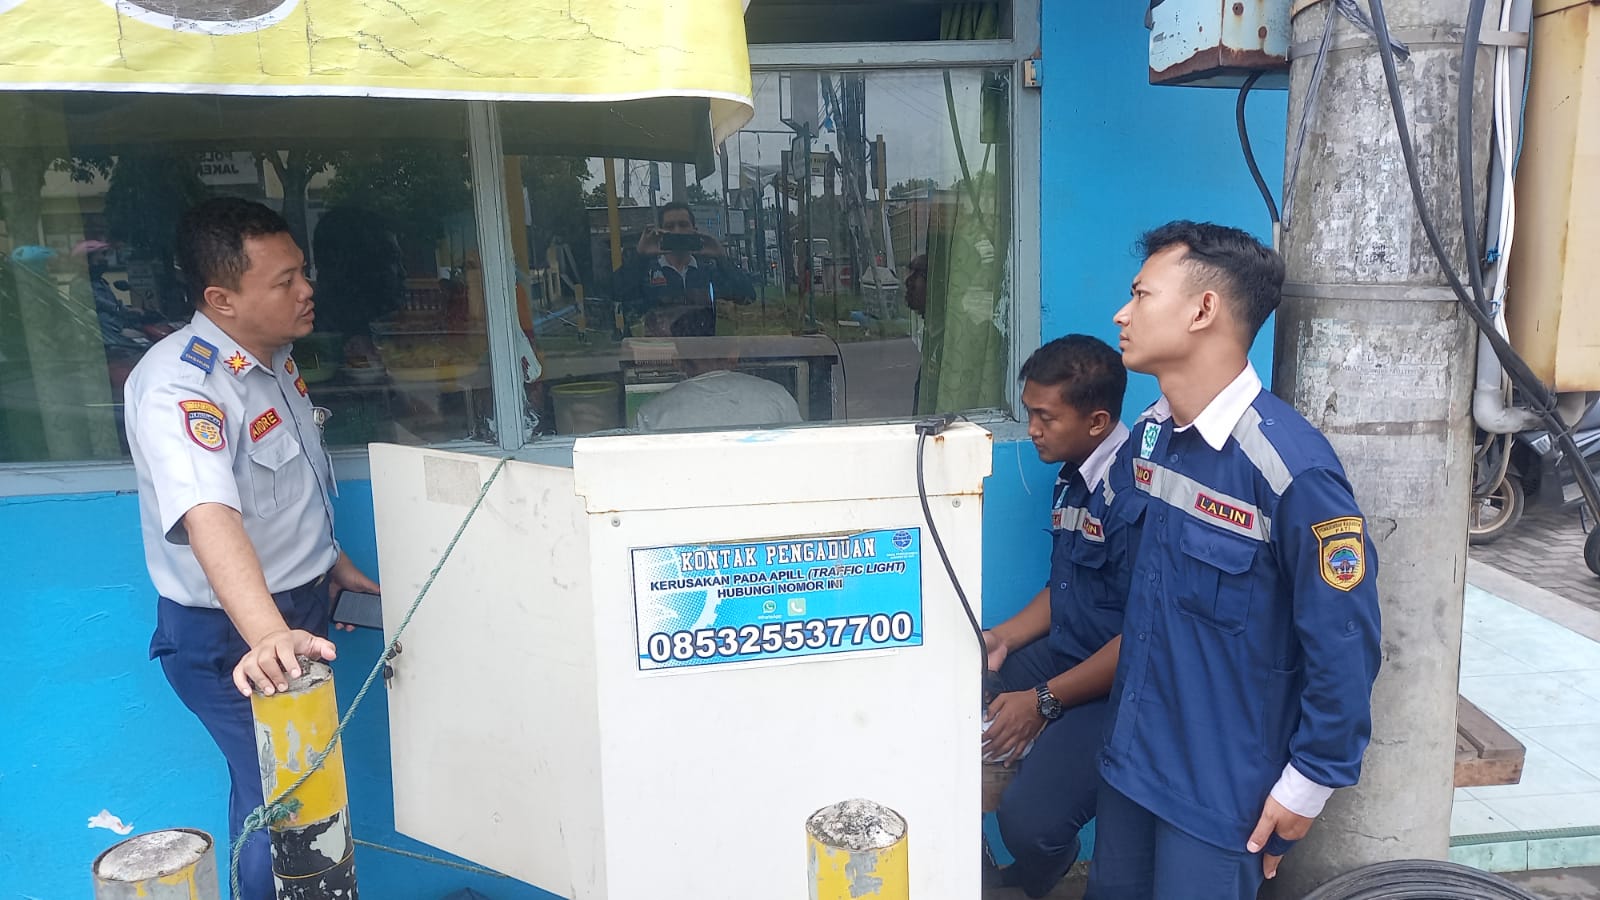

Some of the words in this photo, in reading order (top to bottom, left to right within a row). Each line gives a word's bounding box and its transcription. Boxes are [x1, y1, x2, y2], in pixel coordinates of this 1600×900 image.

[253, 411, 278, 438] ANDRE
[1200, 497, 1246, 524] LALIN
[680, 546, 757, 572] KONTAK
[766, 538, 876, 565] PENGADUAN
[650, 575, 729, 591] KERUSAKAN
[733, 572, 767, 584] PADA
[770, 570, 804, 582] APILL
[808, 564, 863, 580] (TRAFFIC
[866, 562, 906, 574] LIGHT)
[718, 585, 775, 598] HUBUNGI
[778, 580, 825, 593] NOMOR
[828, 579, 843, 589] INI
[647, 612, 913, 662] 085325537700
